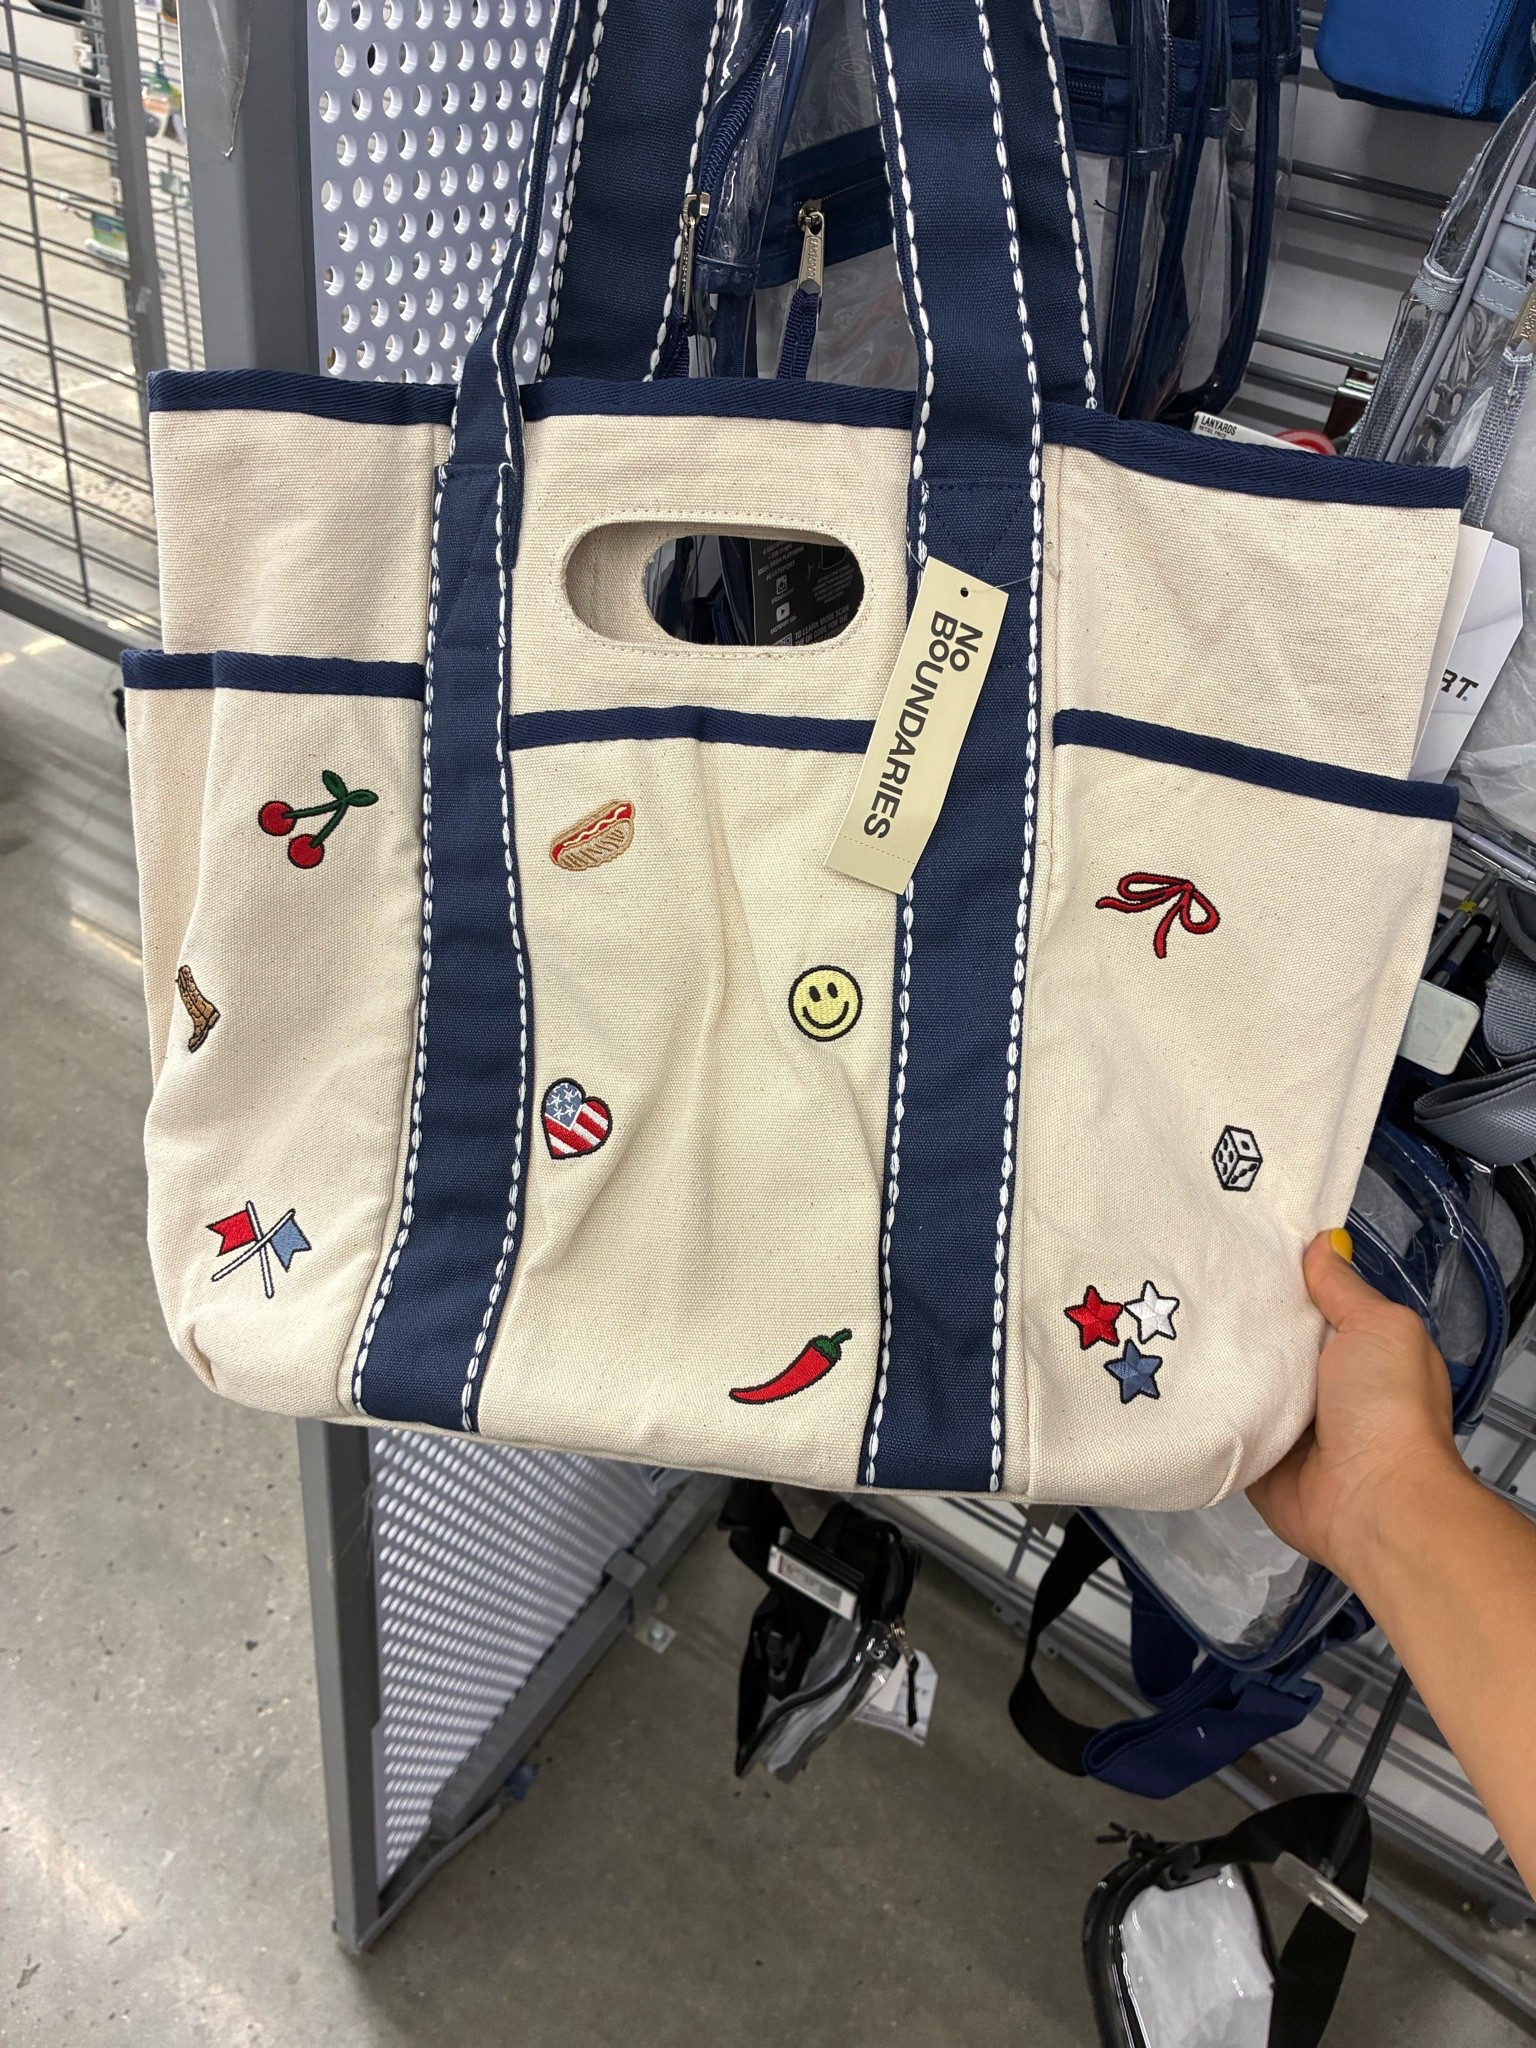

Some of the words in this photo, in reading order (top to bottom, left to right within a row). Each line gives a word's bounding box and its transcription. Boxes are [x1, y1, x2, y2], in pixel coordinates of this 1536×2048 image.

[1201, 415, 1237, 436] LANYARDS
[795, 630, 802, 640] TO
[802, 621, 819, 636] LEARN
[820, 612, 835, 625] MORE
[949, 621, 983, 672] NO
[864, 610, 958, 839] BOUNDARIES
